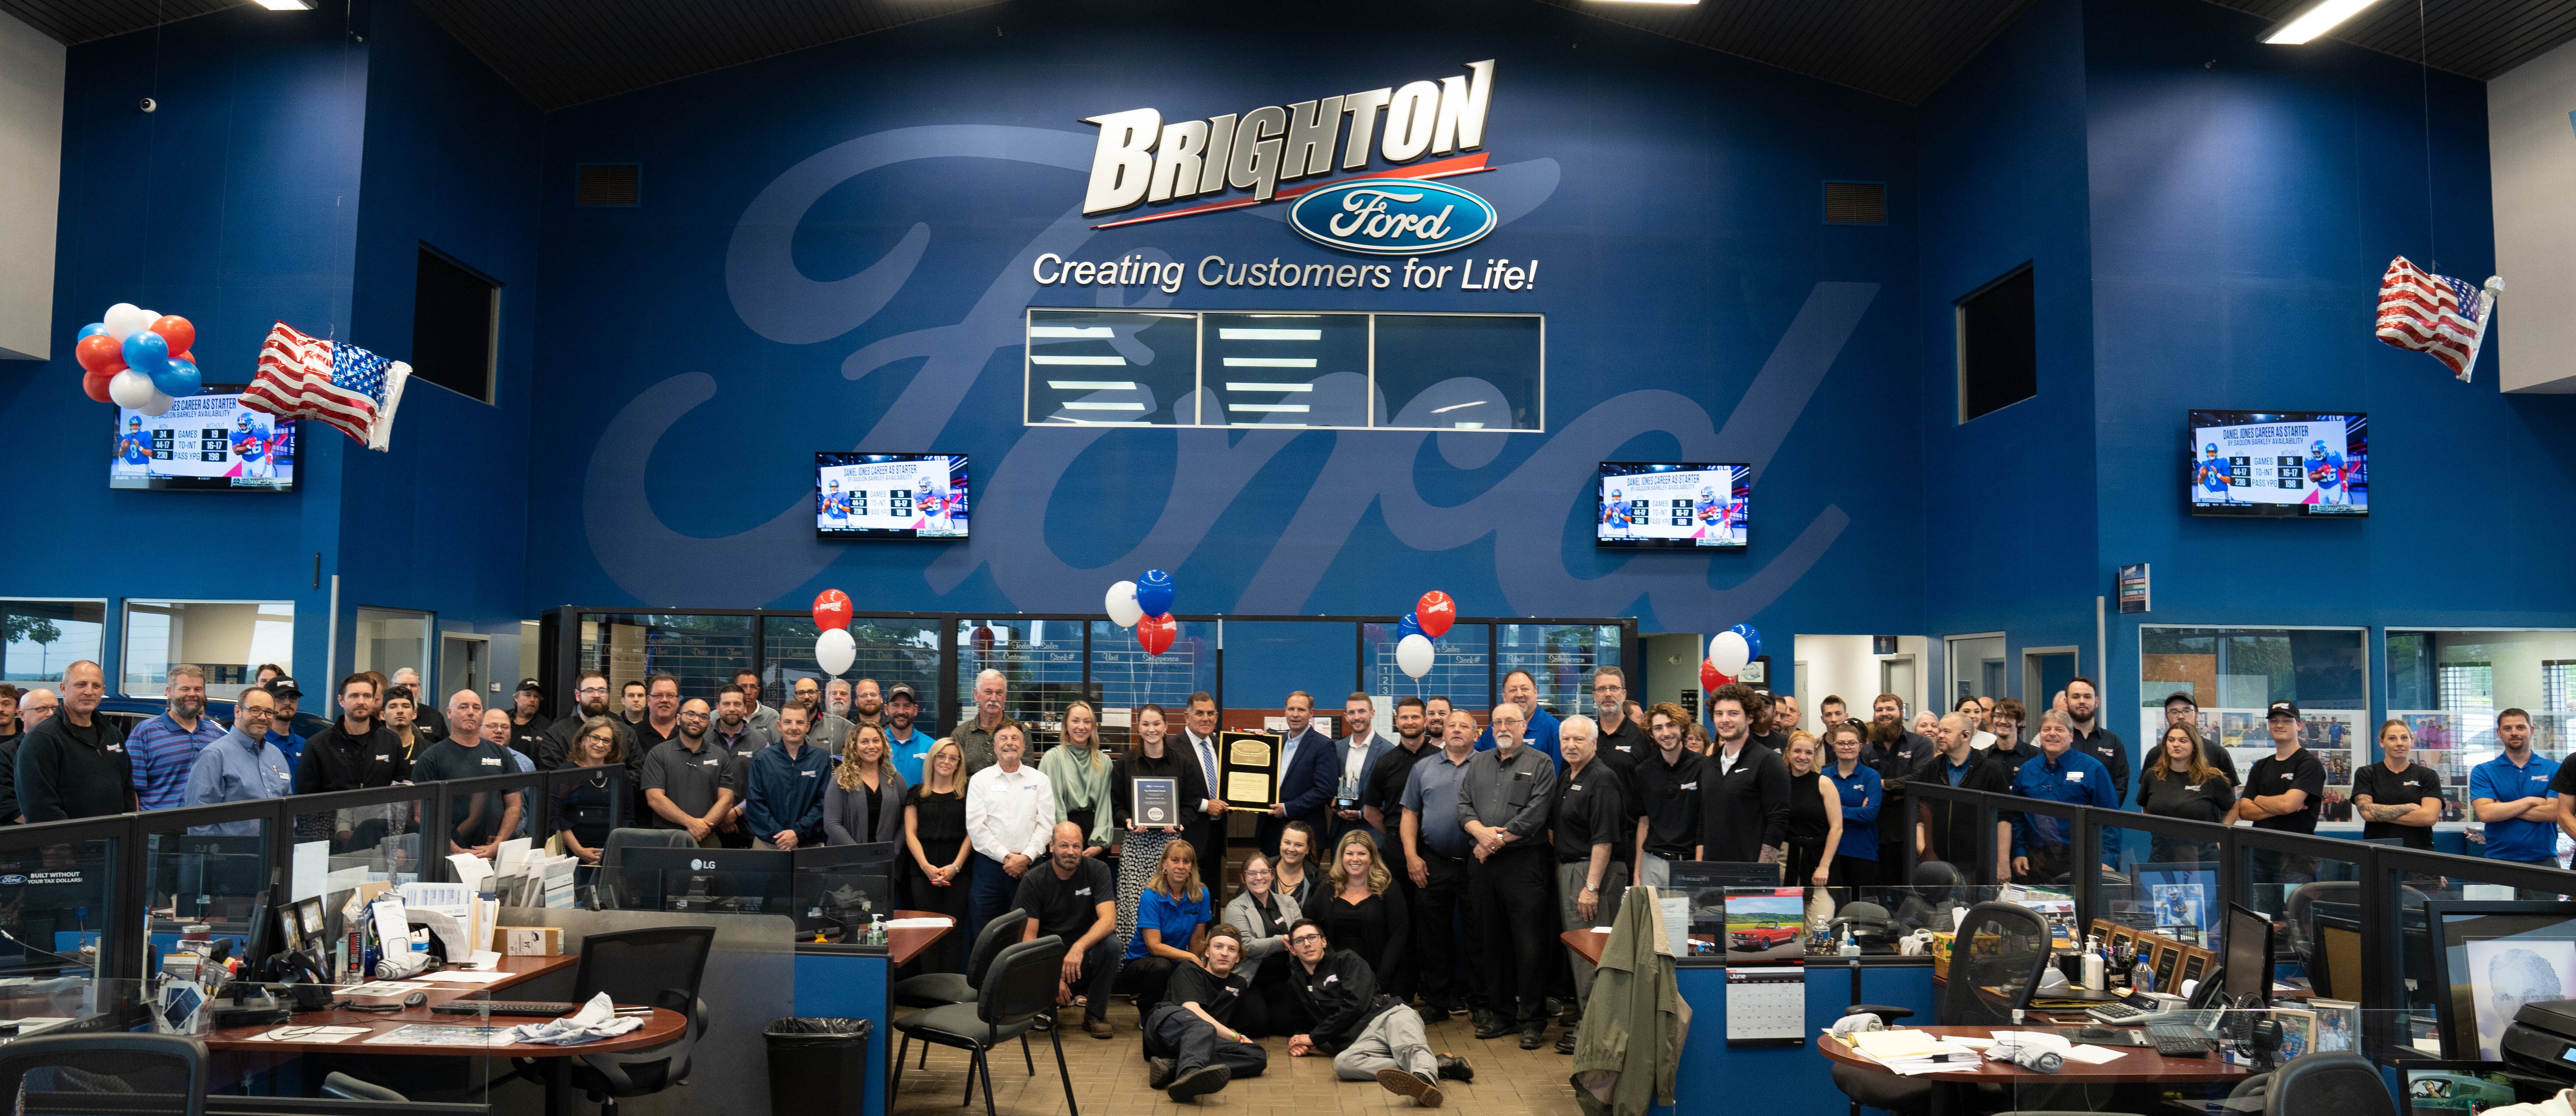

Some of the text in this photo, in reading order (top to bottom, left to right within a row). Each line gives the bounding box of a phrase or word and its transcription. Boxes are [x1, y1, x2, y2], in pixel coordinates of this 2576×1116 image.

[1077, 59, 1495, 215] BRIGHTON
[1329, 189, 1454, 239] Ford
[1032, 253, 1538, 293] Creating Customers for Life!
[585, 124, 1880, 614] Ford
[182, 399, 200, 411] CAREER
[203, 399, 210, 409] AS
[211, 398, 236, 409] STARTER
[2223, 426, 2309, 440] DANIEL JONES CAREER AS STARTER
[207, 441, 221, 450] 16-17
[189, 452, 200, 460] YPG
[208, 453, 219, 461] 198
[2287, 457, 2294, 465] 19
[844, 465, 917, 476] DANIEL JONES CAREER AS STARTER
[1627, 474, 1700, 486] DANIEL JONES CAREER AS STARTER
[1442, 645, 1460, 653] Sales
[703, 861, 715, 869] LG
